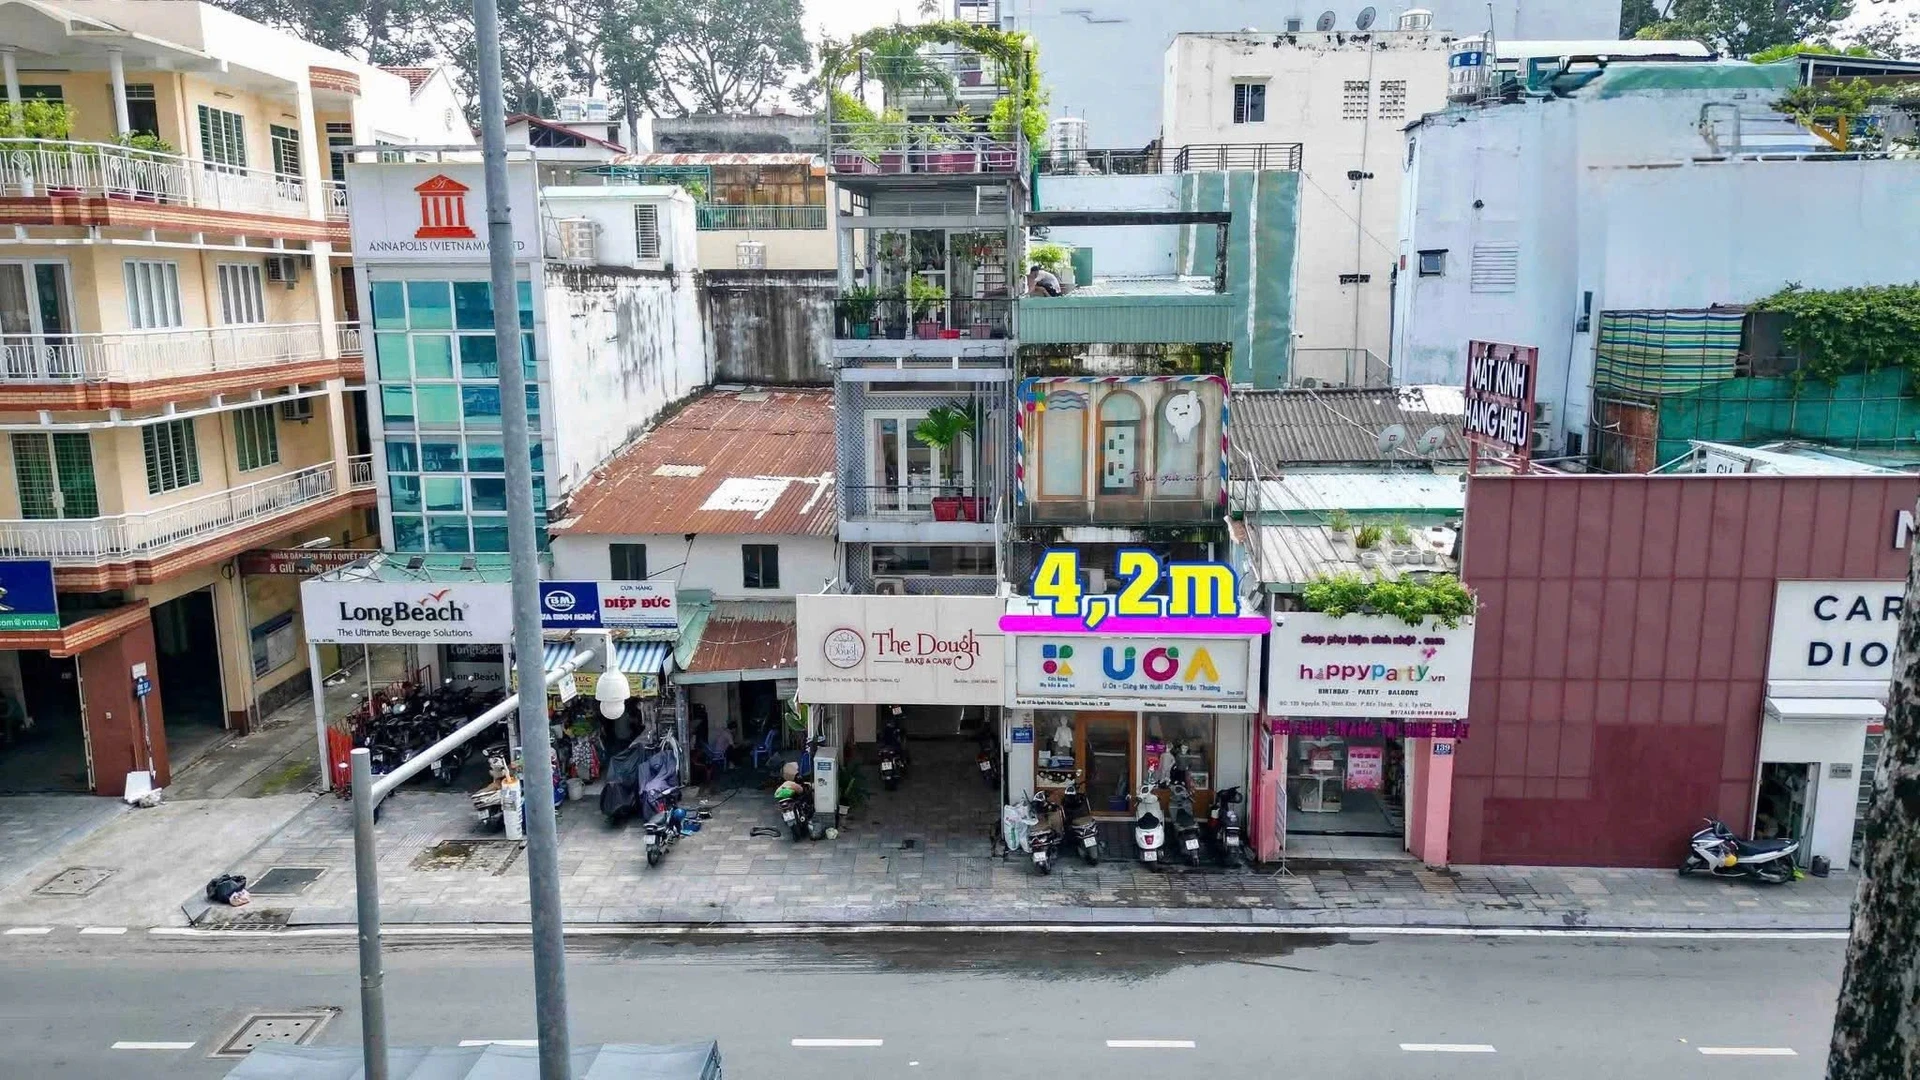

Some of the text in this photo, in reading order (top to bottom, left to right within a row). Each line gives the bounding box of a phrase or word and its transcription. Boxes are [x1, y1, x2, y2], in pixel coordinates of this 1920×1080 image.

[369, 241, 428, 251] ANNAPOLIS
[429, 240, 486, 251] (VIETNAM)
[1470, 344, 1526, 399] MẮT KÍNH
[1463, 391, 1528, 452] HÀNG HIỆU
[269, 563, 277, 573] &
[604, 595, 671, 611] DIỆP ĐỨC
[339, 600, 464, 627] LongBeach
[337, 628, 473, 639] The Ultimate Beverage Solutions
[872, 628, 981, 671] The Dough
[904, 657, 925, 666] BAKE
[932, 657, 953, 666] CAKE
[1318, 688, 1349, 696] BIRTHDAY
[1436, 744, 1451, 752] 139
